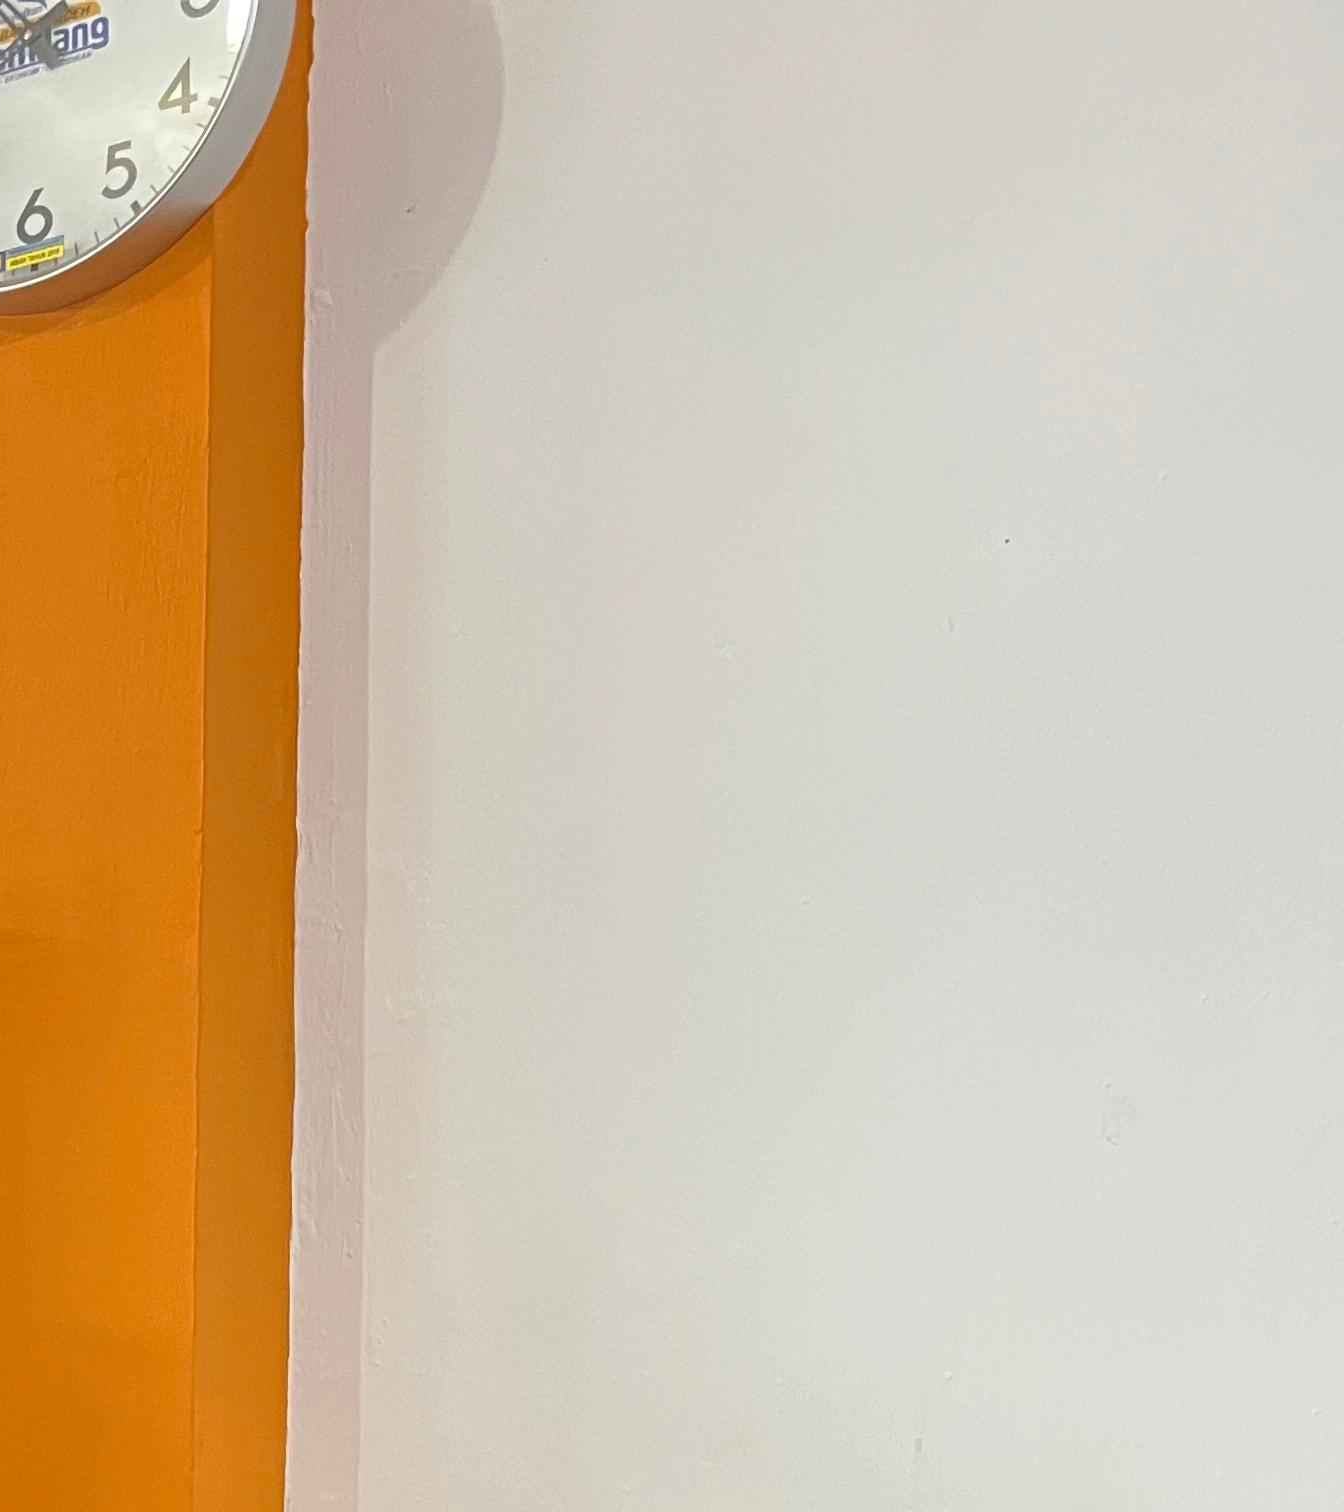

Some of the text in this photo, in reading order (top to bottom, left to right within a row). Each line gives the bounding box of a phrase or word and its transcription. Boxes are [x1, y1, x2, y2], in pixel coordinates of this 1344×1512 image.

[158, 56, 198, 114] 4
[101, 140, 137, 199] 5
[16, 187, 53, 244] 6
